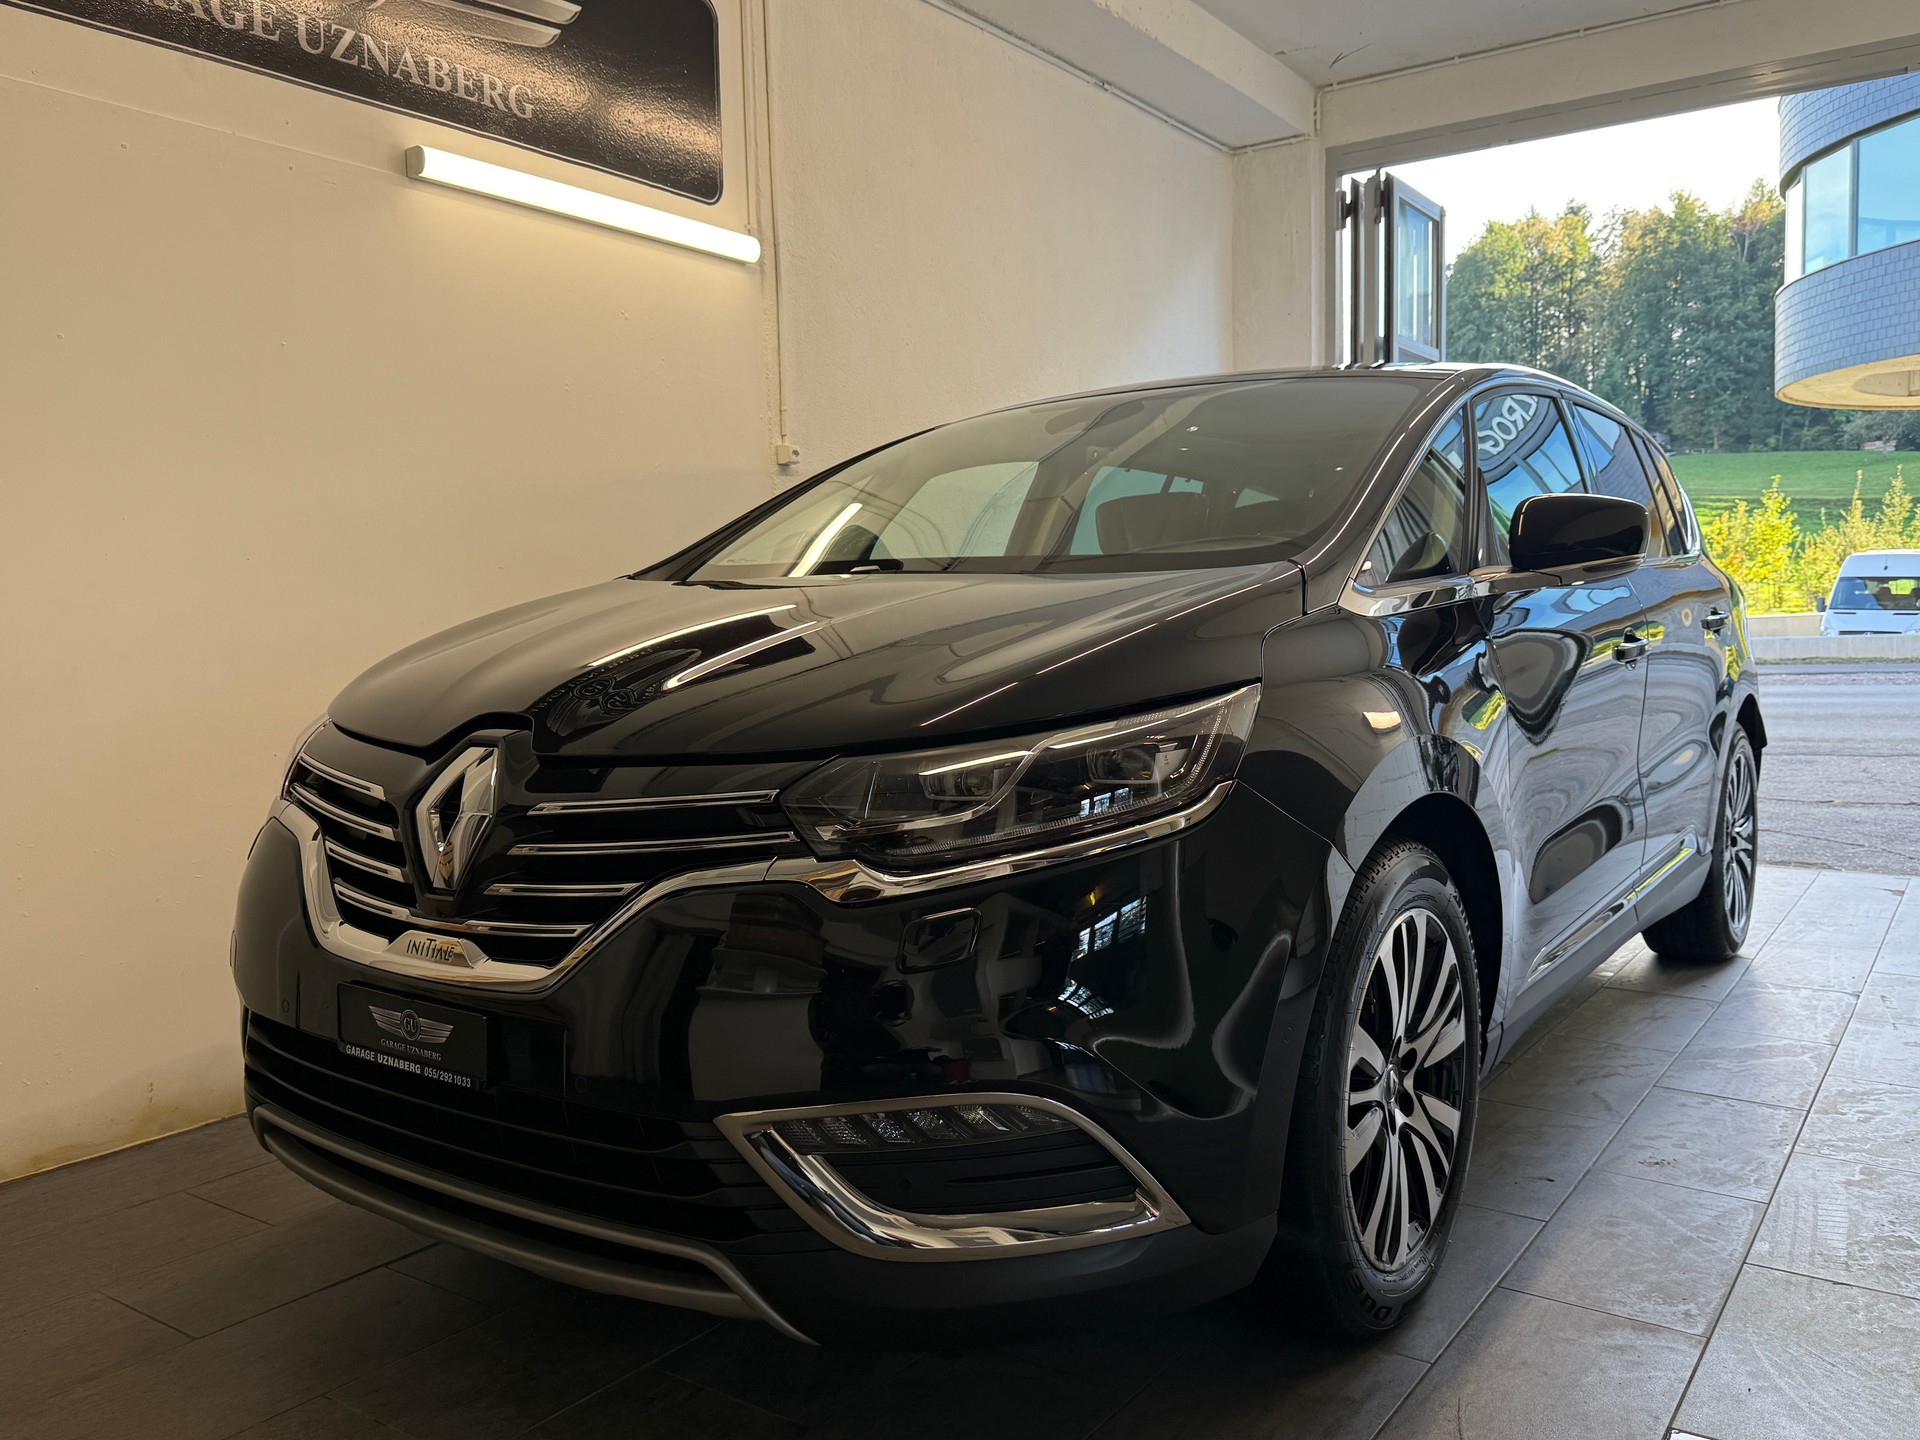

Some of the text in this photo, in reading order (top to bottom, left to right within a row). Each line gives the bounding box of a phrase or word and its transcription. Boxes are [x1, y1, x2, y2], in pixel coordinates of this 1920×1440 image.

[296, 14, 534, 119] UZNABERG
[406, 938, 455, 961] INITIALE
[403, 1017, 417, 1033] GU
[345, 1044, 375, 1061] GARAGE
[377, 1053, 421, 1074] UZNABERG
[380, 1038, 442, 1061] GARAGE UZNABERG
